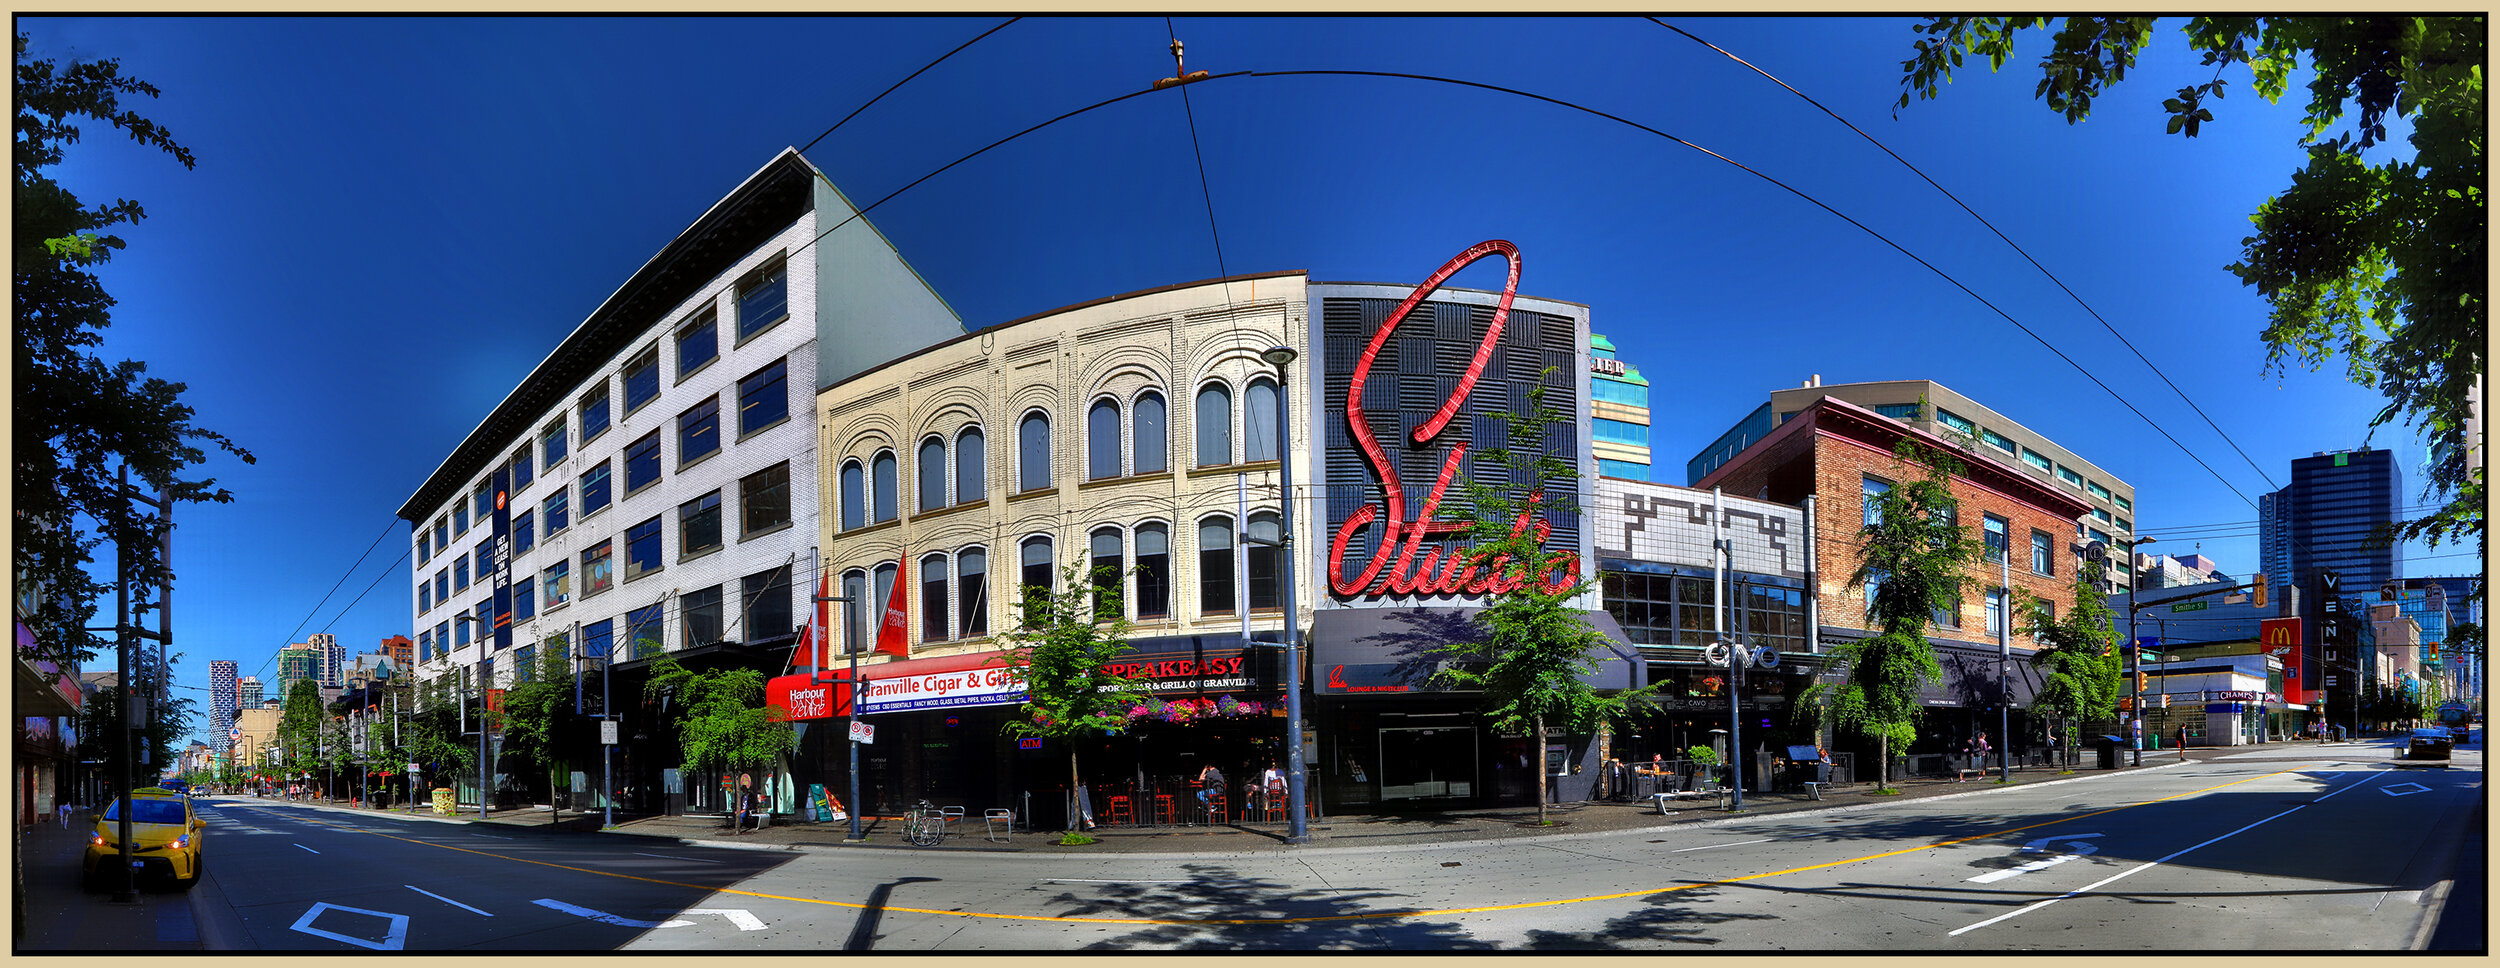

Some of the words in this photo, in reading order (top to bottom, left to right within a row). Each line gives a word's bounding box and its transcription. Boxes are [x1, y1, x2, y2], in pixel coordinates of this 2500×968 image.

[1591, 357, 1625, 375] IER
[1330, 239, 1580, 595] Studio
[496, 534, 506, 547] GET
[494, 548, 499, 557] A
[498, 541, 509, 554] NEW
[494, 551, 509, 565] LEASE
[498, 561, 506, 571] ON
[495, 569, 509, 582] WORK
[496, 579, 508, 590] LIFE.
[888, 607, 906, 618] Harbour
[2175, 604, 2196, 612] Smithe
[2323, 574, 2338, 687] VENUE
[1100, 657, 1244, 680] SPEAKEASY
[861, 676, 920, 697] Granville
[923, 675, 962, 696] Cigar
[966, 672, 981, 688] &
[1152, 682, 1161, 690] &
[1161, 681, 1188, 690] GRILL
[1188, 680, 1202, 689] ON
[1203, 678, 1256, 688] GRANVILLE
[789, 688, 826, 700] Harbour
[790, 698, 826, 709] DANCE
[1688, 699, 1707, 707] CAVO
[1547, 726, 1565, 735] ATM
[1021, 739, 1041, 749] ATM
